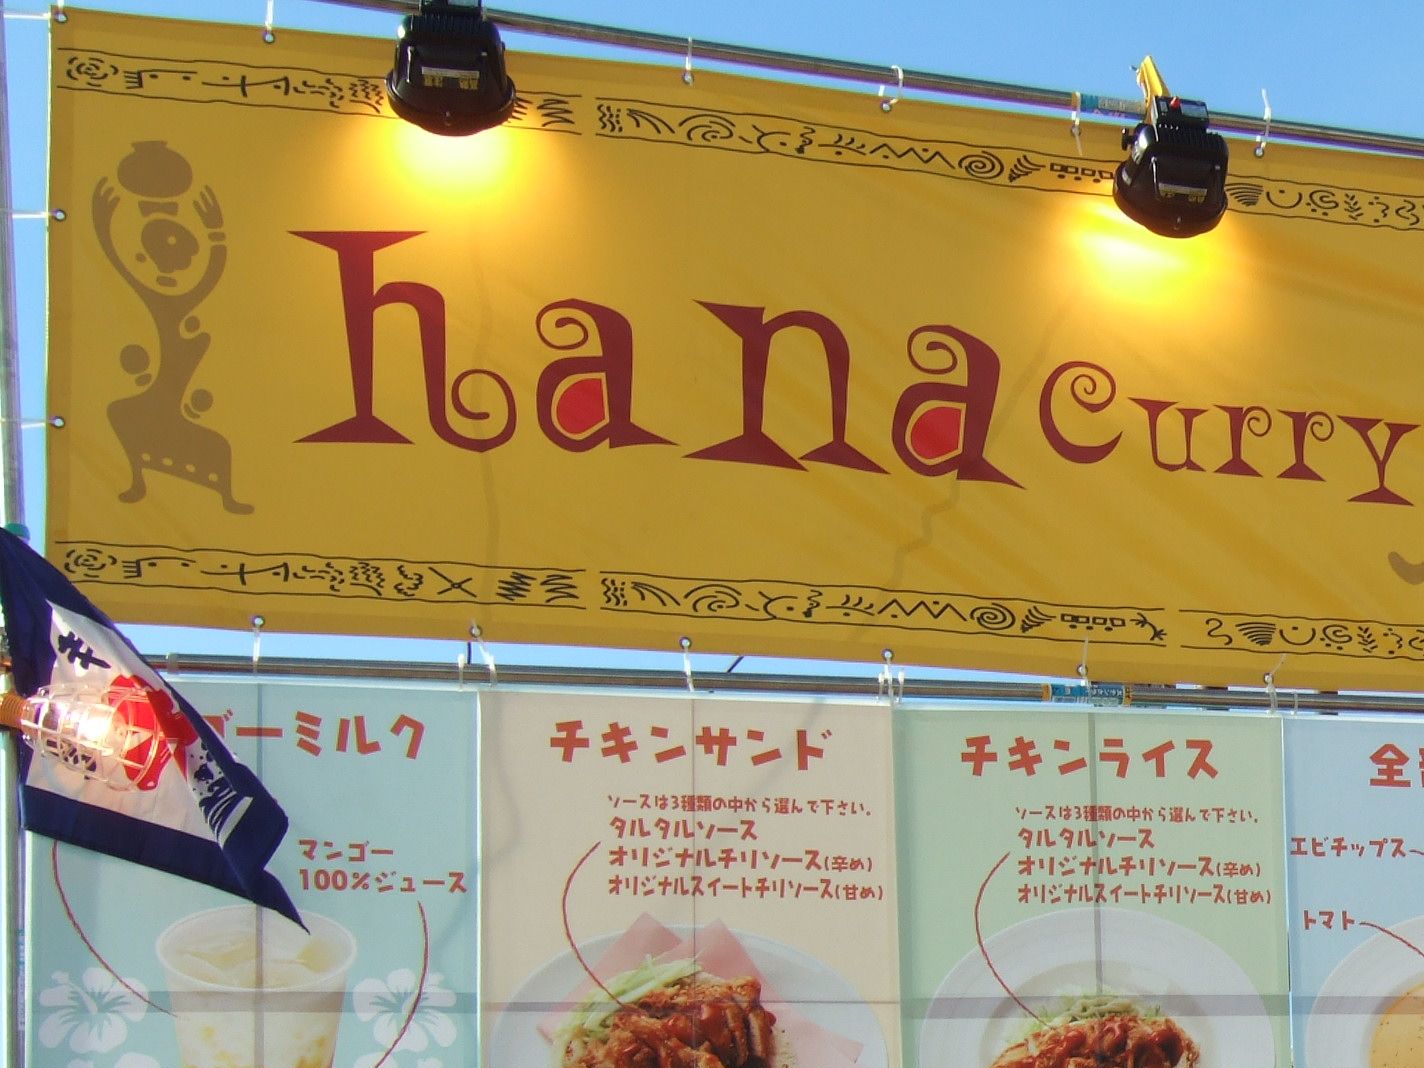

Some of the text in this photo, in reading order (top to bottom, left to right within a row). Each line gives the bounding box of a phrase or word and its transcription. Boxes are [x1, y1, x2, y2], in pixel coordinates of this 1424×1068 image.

[288, 230, 1026, 489] hana
[550, 719, 834, 771] チキンサンド
[961, 734, 1219, 780] チキンライス
[609, 816, 758, 841] タルタルソース
[1017, 827, 1156, 850] タルタルソース
[298, 839, 394, 862] マンゴー
[1290, 837, 1408, 859] エビチップス
[1302, 910, 1356, 931] トマト
